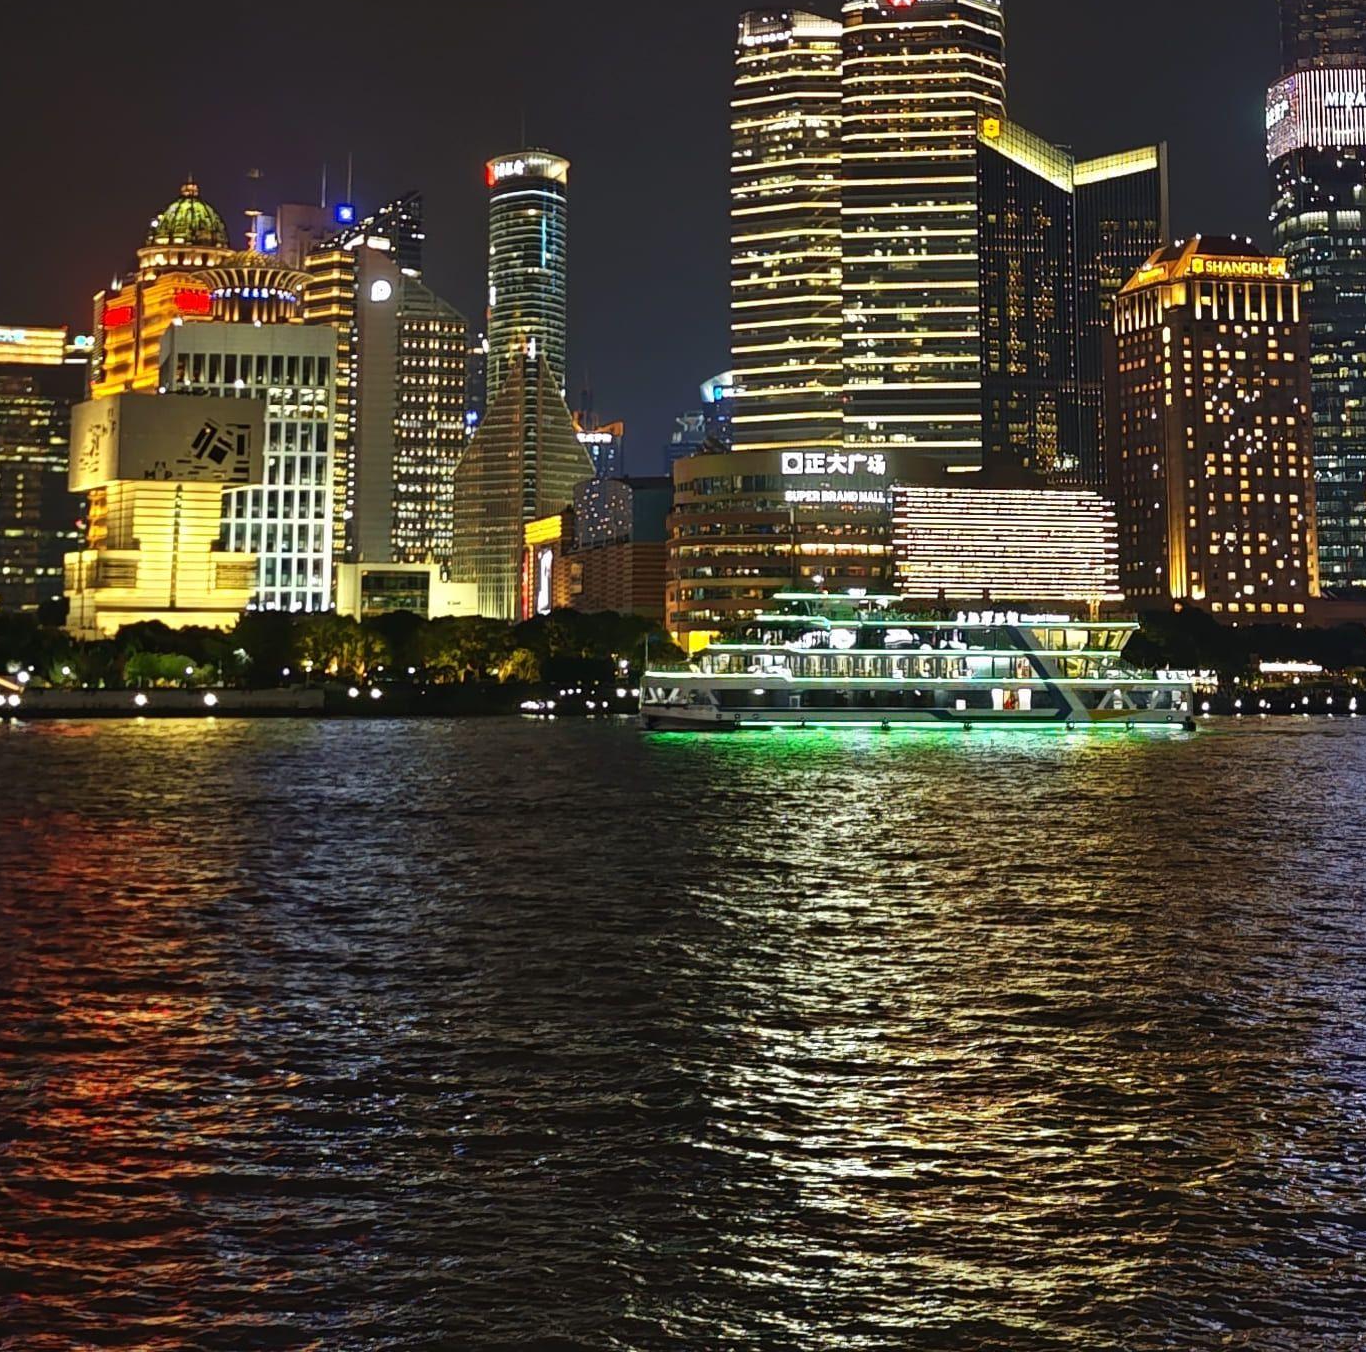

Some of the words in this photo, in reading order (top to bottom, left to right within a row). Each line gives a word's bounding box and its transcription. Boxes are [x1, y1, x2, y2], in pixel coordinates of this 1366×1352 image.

[1205, 259, 1286, 276] SHANGRI-LA
[804, 452, 886, 476] 正大广场
[785, 490, 821, 502] SUPER
[821, 490, 859, 503] BRAND
[859, 491, 886, 503] MALL
